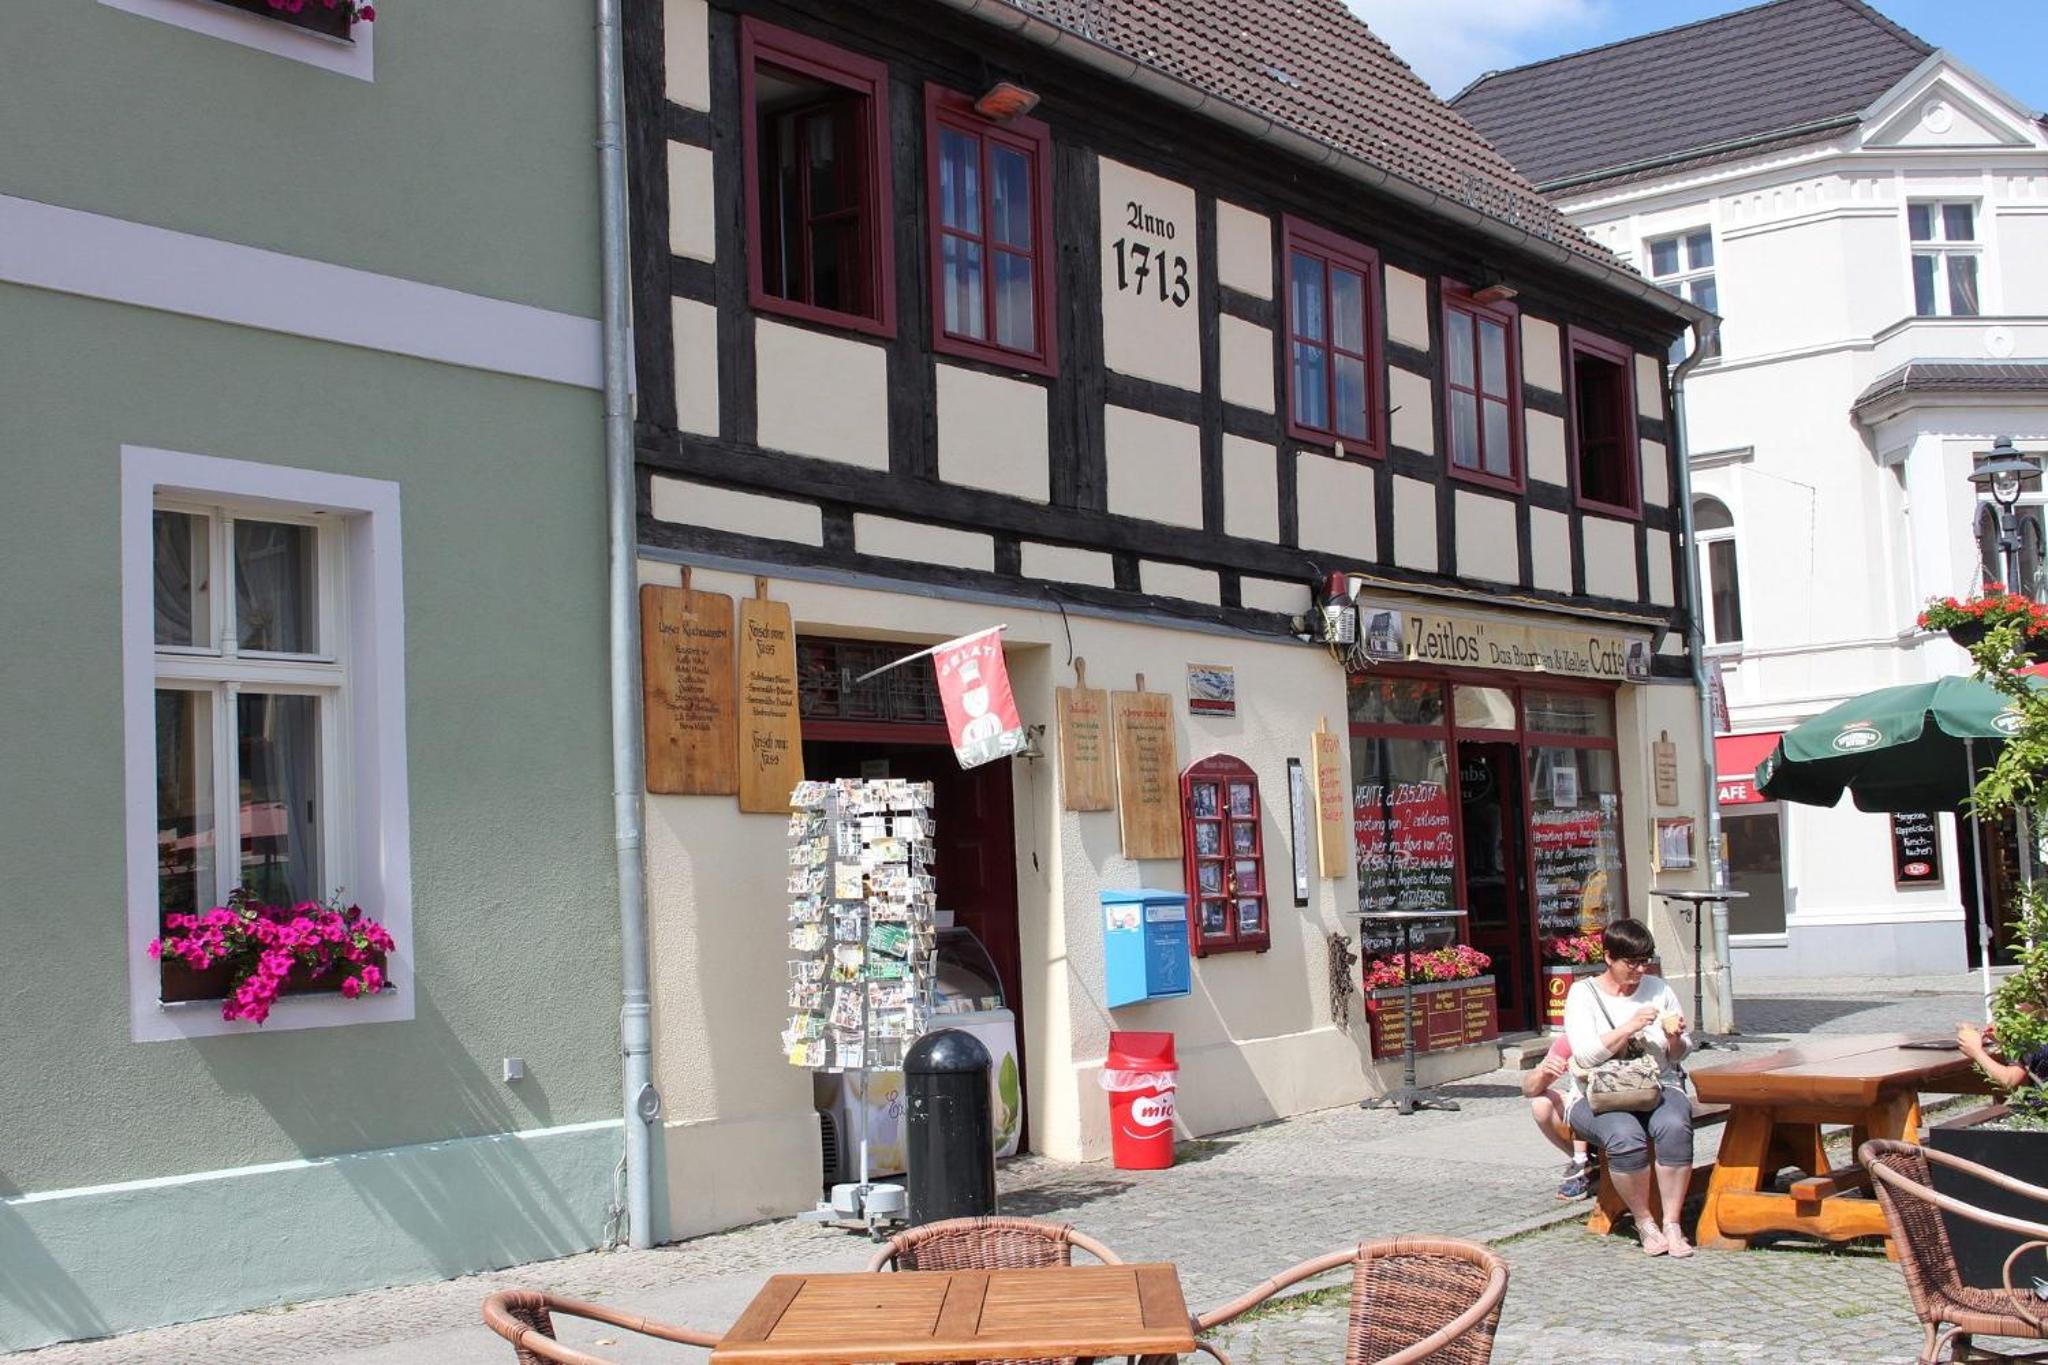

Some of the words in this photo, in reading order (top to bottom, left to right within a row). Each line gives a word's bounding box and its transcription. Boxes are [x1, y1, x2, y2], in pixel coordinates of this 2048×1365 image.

[1126, 201, 1175, 239] Anno
[1112, 238, 1190, 308] 1713
[1490, 642, 1511, 664] Das
[1589, 639, 1624, 675] Café
